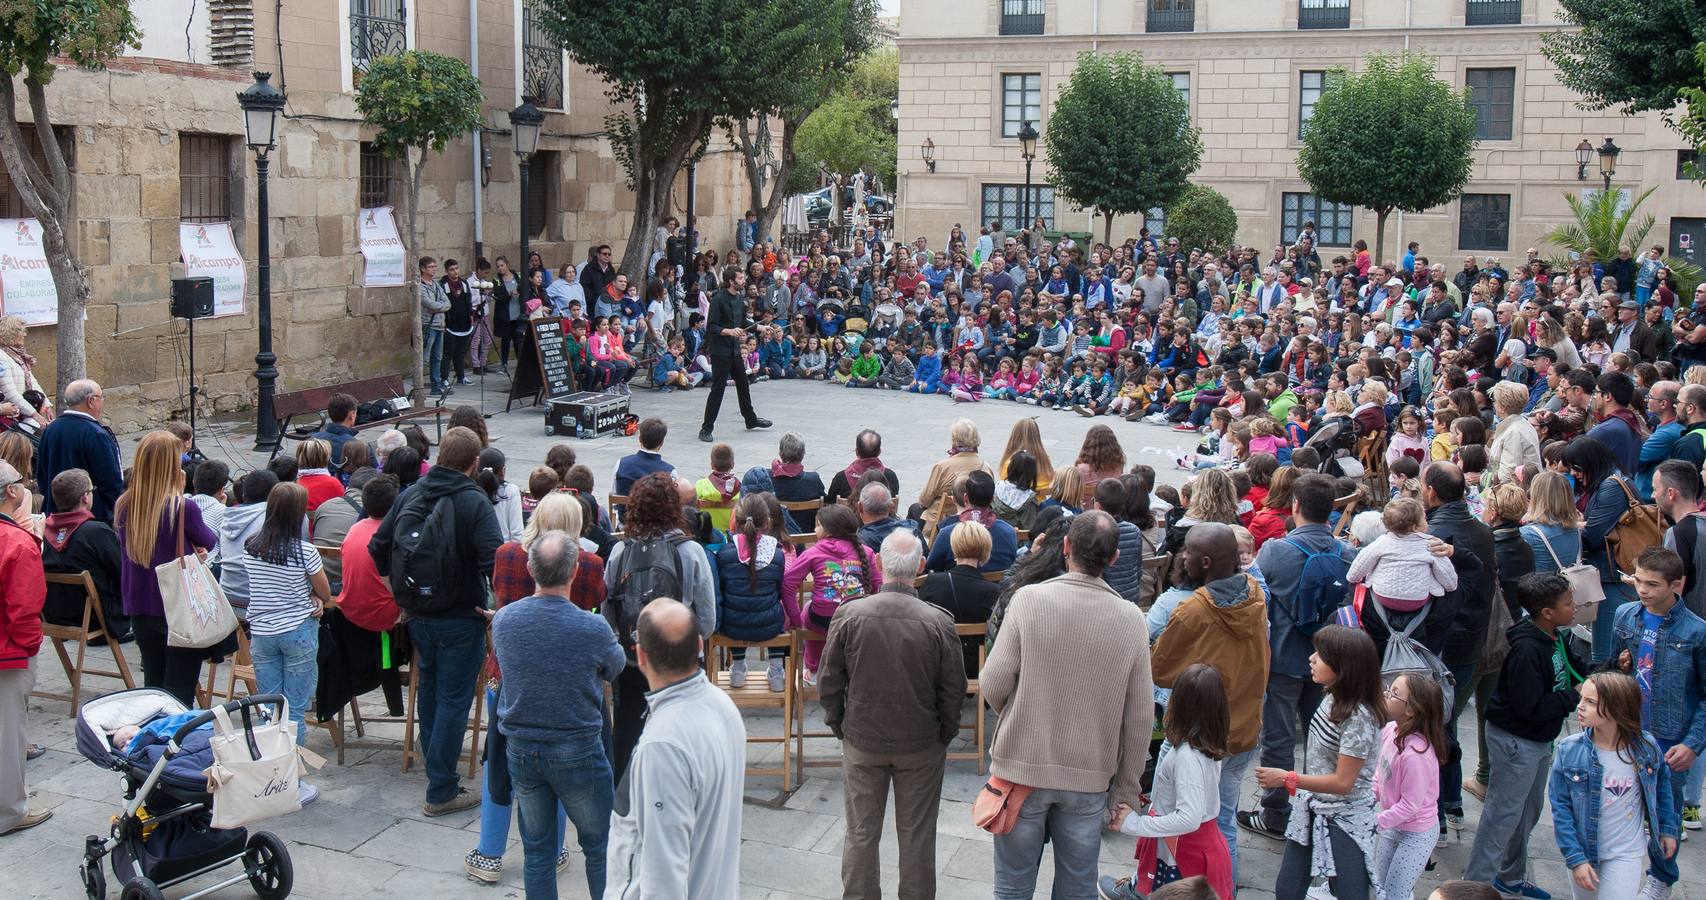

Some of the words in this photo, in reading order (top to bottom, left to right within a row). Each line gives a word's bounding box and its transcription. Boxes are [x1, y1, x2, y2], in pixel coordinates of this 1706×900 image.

[189, 254, 240, 270] Alcampo
[20, 280, 55, 289] EMPRES
[7, 289, 57, 299] COLABORAD
[254, 778, 288, 798] Aritz
[1604, 775, 1633, 788] LOVE
